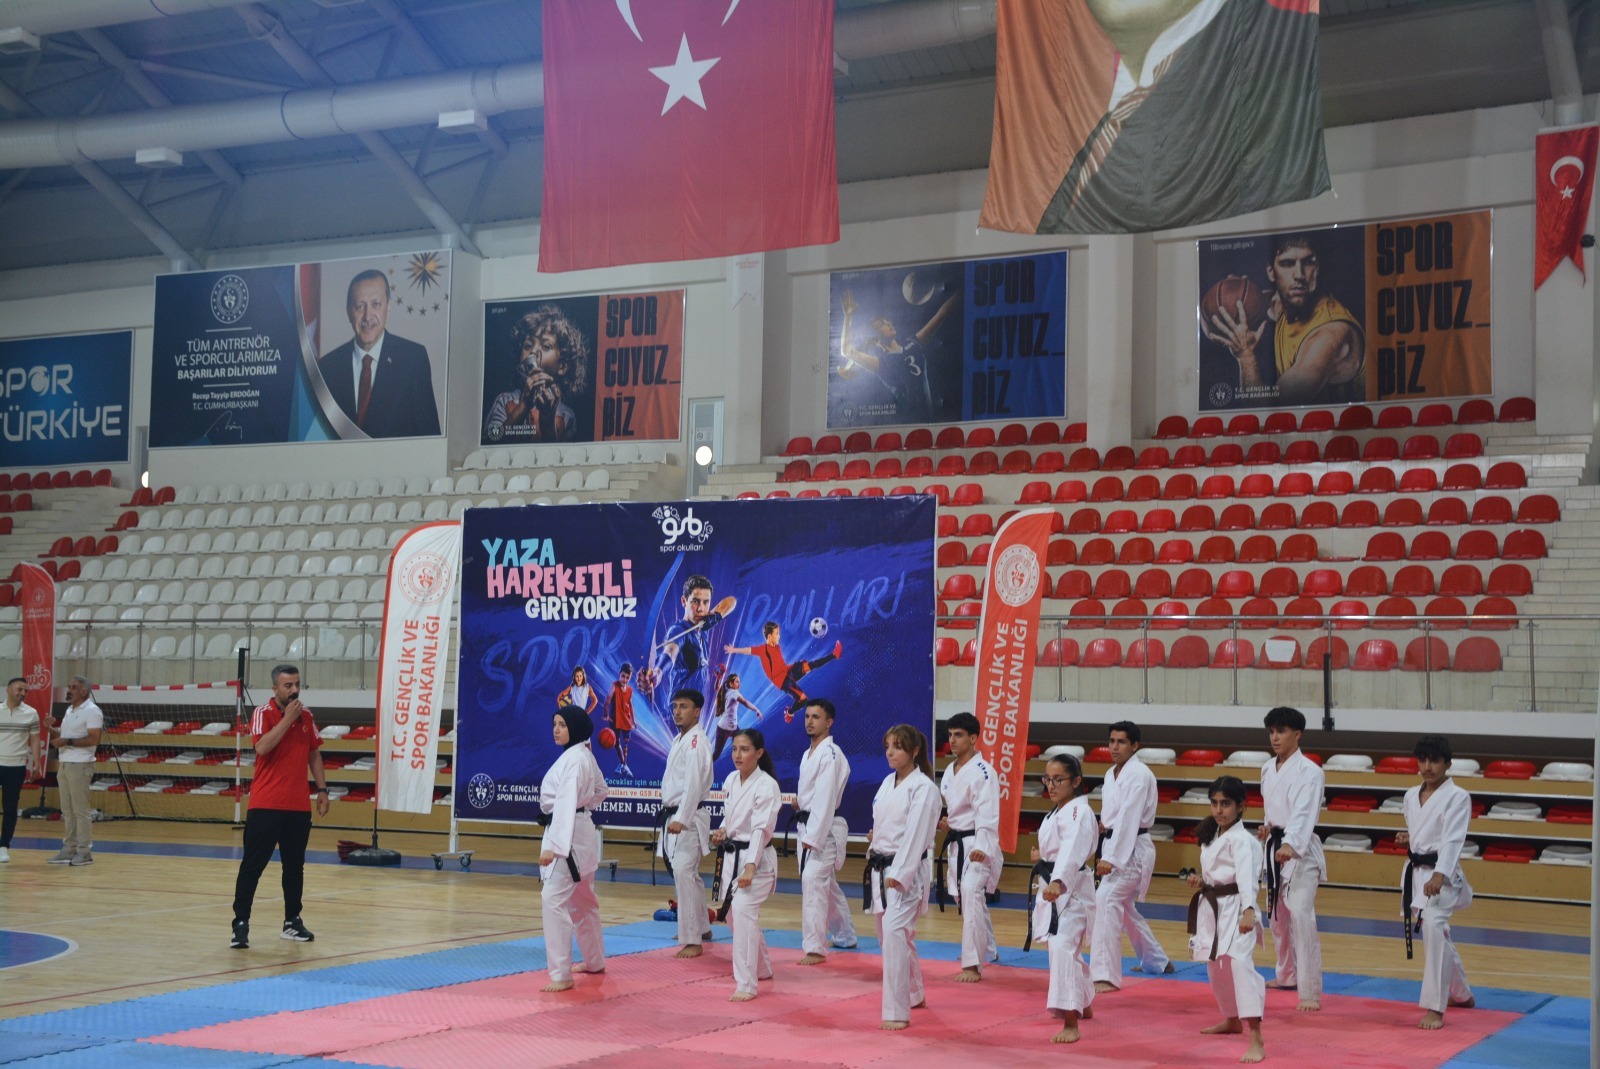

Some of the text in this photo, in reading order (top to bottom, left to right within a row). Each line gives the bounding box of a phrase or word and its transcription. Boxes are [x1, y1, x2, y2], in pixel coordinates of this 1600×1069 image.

[1377, 221, 1453, 276] SPOR
[974, 260, 1035, 307] SPOR
[606, 296, 658, 338] SPOR
[175, 349, 281, 367] VE SPORCULARIMIZA
[187, 334, 270, 352] TÜM ANTRENÖR
[0, 364, 73, 398] POR
[177, 365, 277, 381] BAŞARILAR DİLİYORUM
[1377, 341, 1426, 398] BİZ
[204, 400, 259, 410] CUMHURBAŞKANI
[210, 392, 229, 400] Tayyip
[230, 389, 260, 398] ERDOĞAN
[972, 366, 1011, 416] BİZ
[1246, 385, 1270, 393] GENÇLİK
[0, 401, 122, 441] ÜRKİYE
[602, 392, 636, 439] BİZ
[662, 507, 702, 544] gsb
[481, 537, 556, 568] YAZA
[660, 545, 675, 553] spor
[487, 559, 633, 598] HAREKETLİ
[525, 596, 637, 620] GİRİYORUZ
[417, 616, 440, 716] BAKANLIĞI
[477, 620, 628, 714] SPOR
[982, 653, 1006, 746] GENÇLİK
[995, 622, 1009, 649] VE
[1003, 619, 1028, 737] BAKANLIĞI
[391, 620, 419, 761] T.C. GENÇLİK VE
[411, 722, 429, 770] SPOR
[498, 784, 538, 794] T.C. GENÇLİK
[635, 779, 647, 787] için
[1000, 743, 1014, 800] SPOR
[514, 794, 540, 802] BAKANL
[595, 802, 664, 816] HEMEN BAŞV
